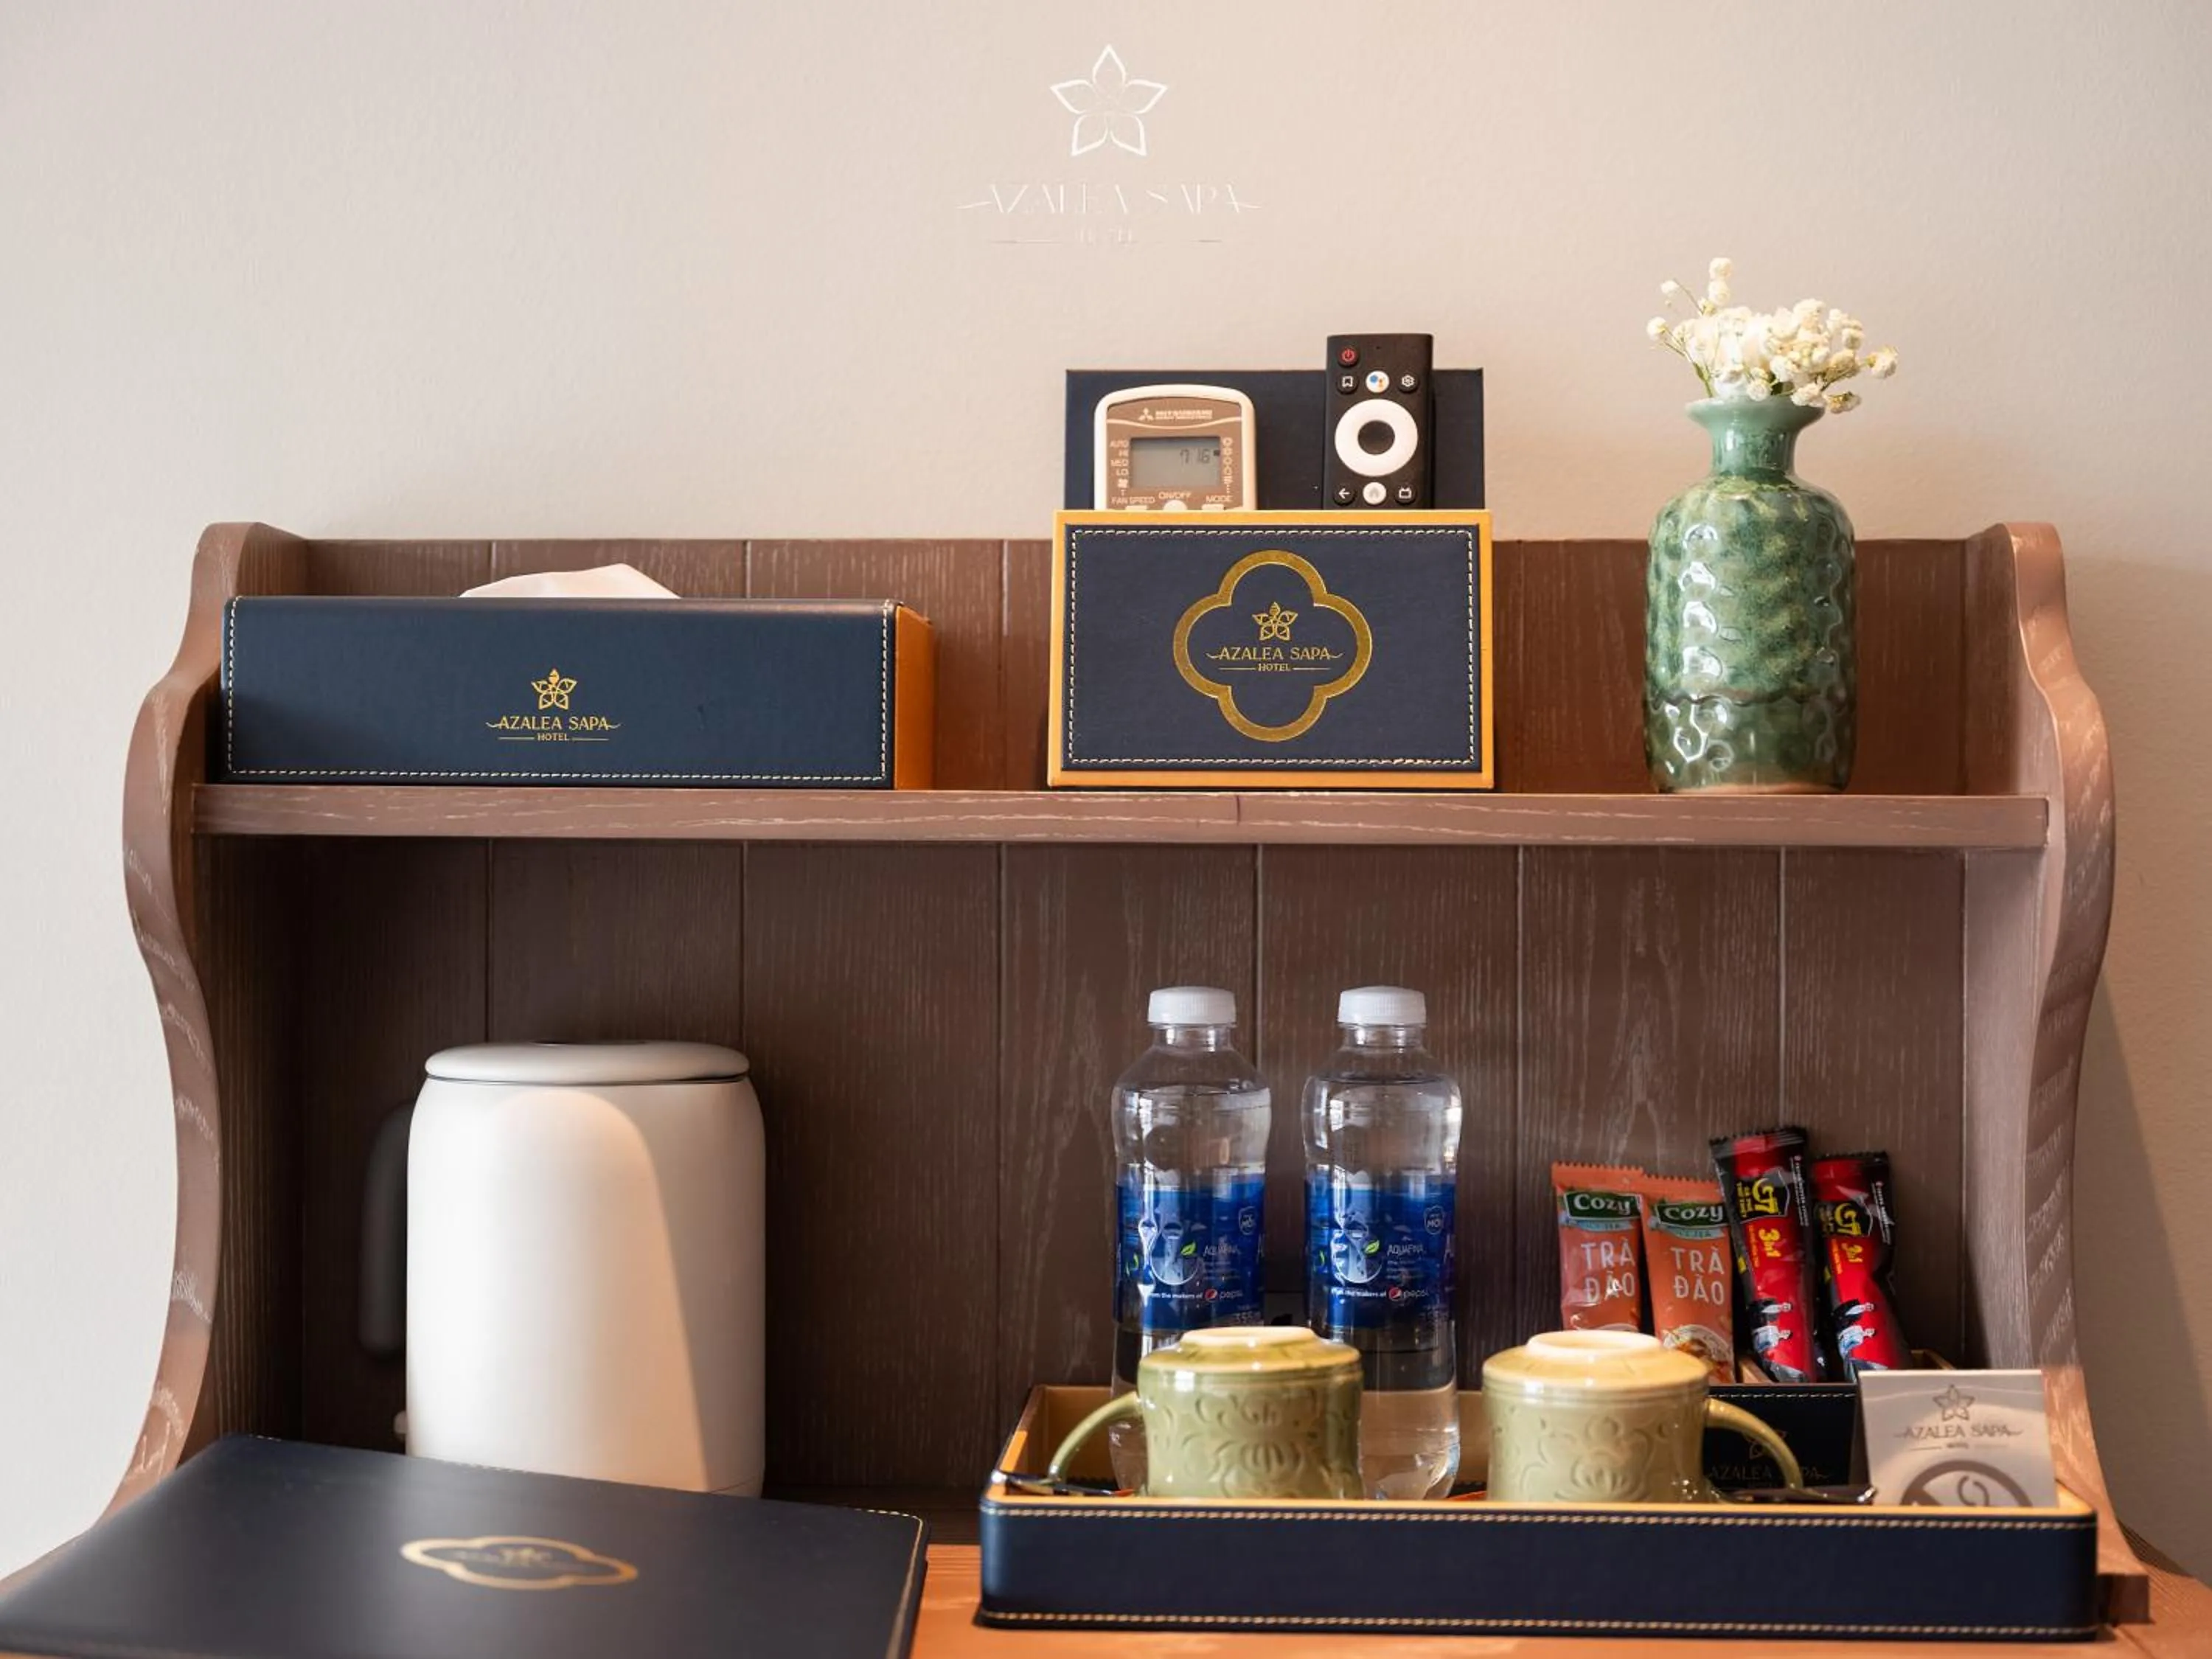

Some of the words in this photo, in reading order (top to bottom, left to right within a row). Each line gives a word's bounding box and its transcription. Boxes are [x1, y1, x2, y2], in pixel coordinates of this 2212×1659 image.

[1206, 495, 1232, 503] MODE
[1216, 647, 1284, 661] AZALEA
[1290, 647, 1333, 661] SAPA
[1257, 664, 1290, 672] HOTEL
[498, 716, 563, 731] AZALEA
[568, 716, 612, 731] SAPA
[537, 732, 569, 742] HOTEL
[1573, 1193, 1632, 1215] Cozy
[1664, 1205, 1724, 1222] Cozy
[1580, 1237, 1636, 1269] TRÀ
[1670, 1246, 1725, 1274] TRÀ
[1673, 1273, 1725, 1306] ĐÀO
[1904, 1425, 1965, 1439] AZALEA
[1970, 1425, 2012, 1437] SAPA
